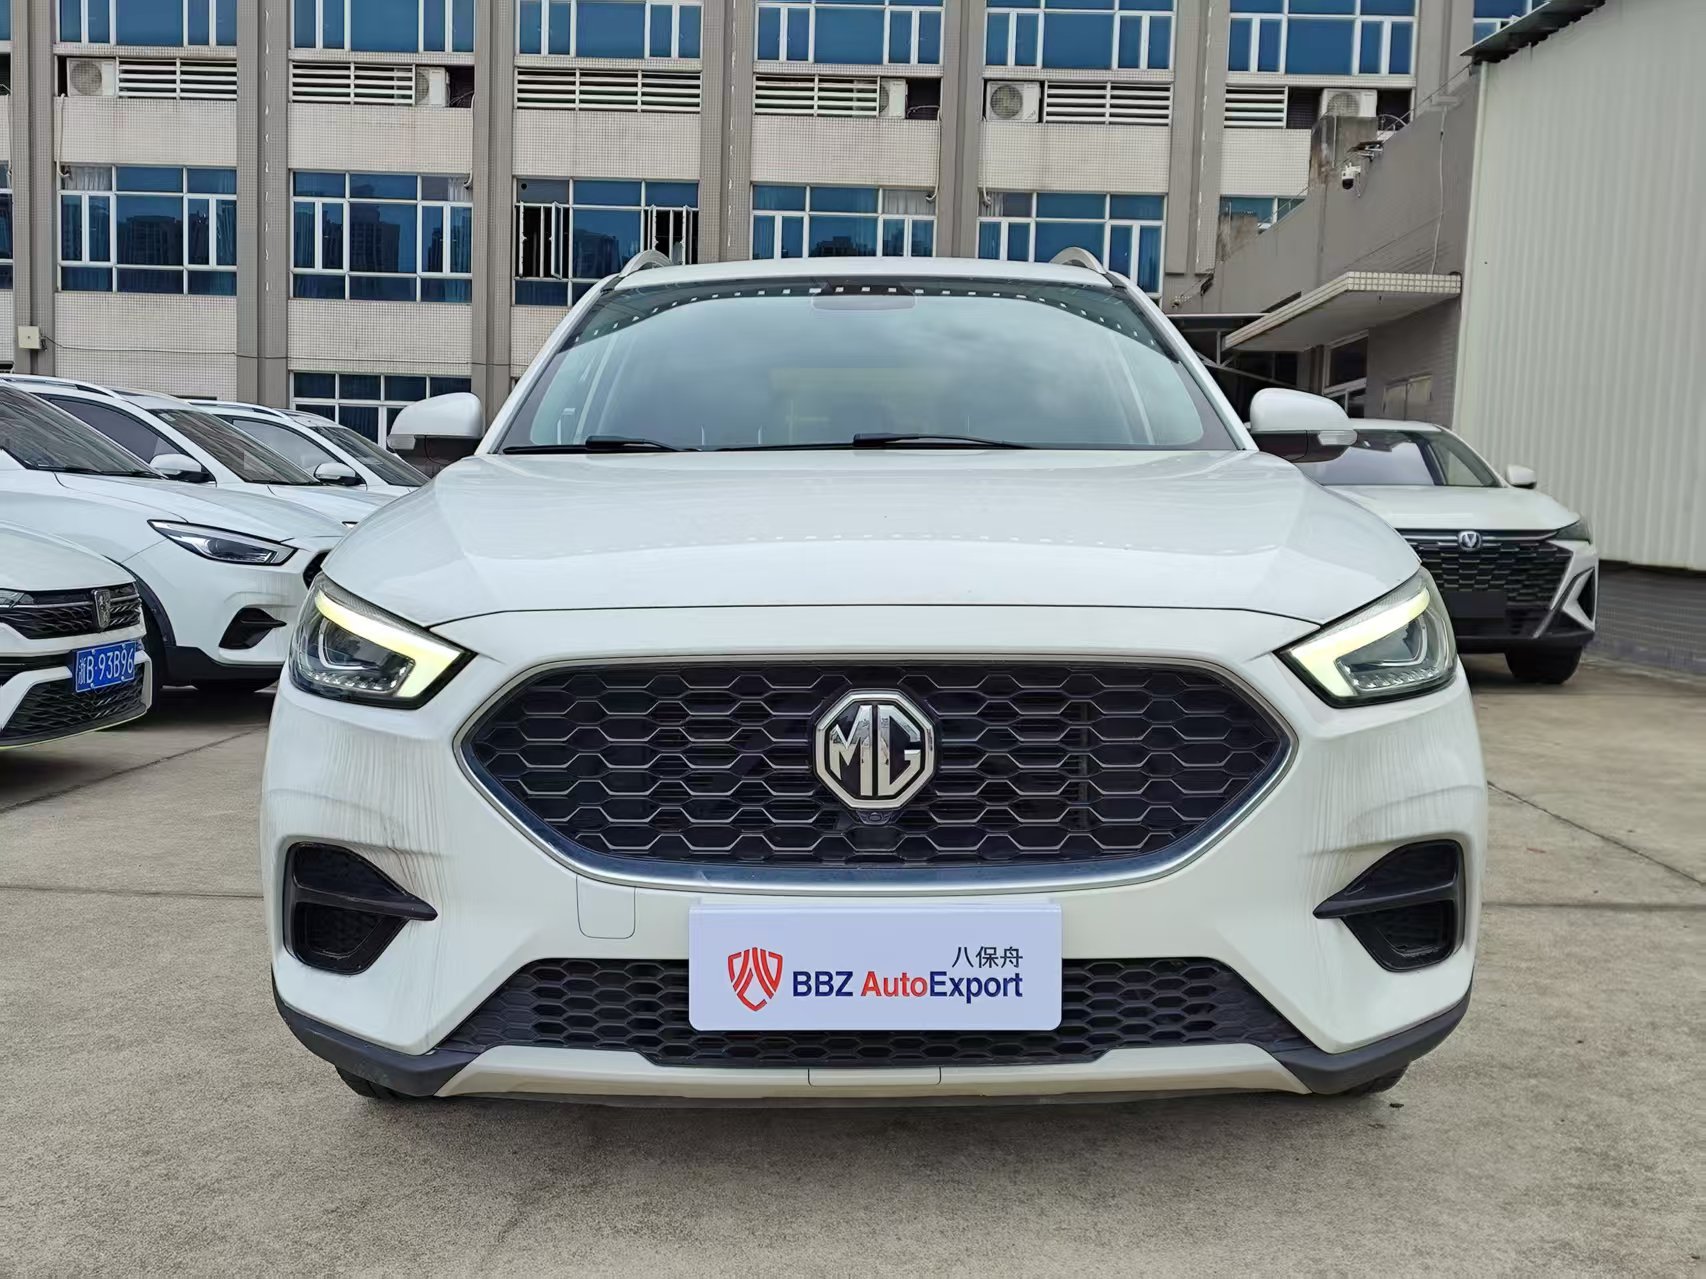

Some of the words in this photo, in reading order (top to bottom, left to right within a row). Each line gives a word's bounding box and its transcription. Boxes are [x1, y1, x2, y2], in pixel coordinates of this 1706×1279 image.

[829, 704, 921, 796] MG
[951, 945, 1024, 969] 八保舟
[792, 970, 854, 998] BBZ
[860, 970, 1024, 1005] AutoExport
